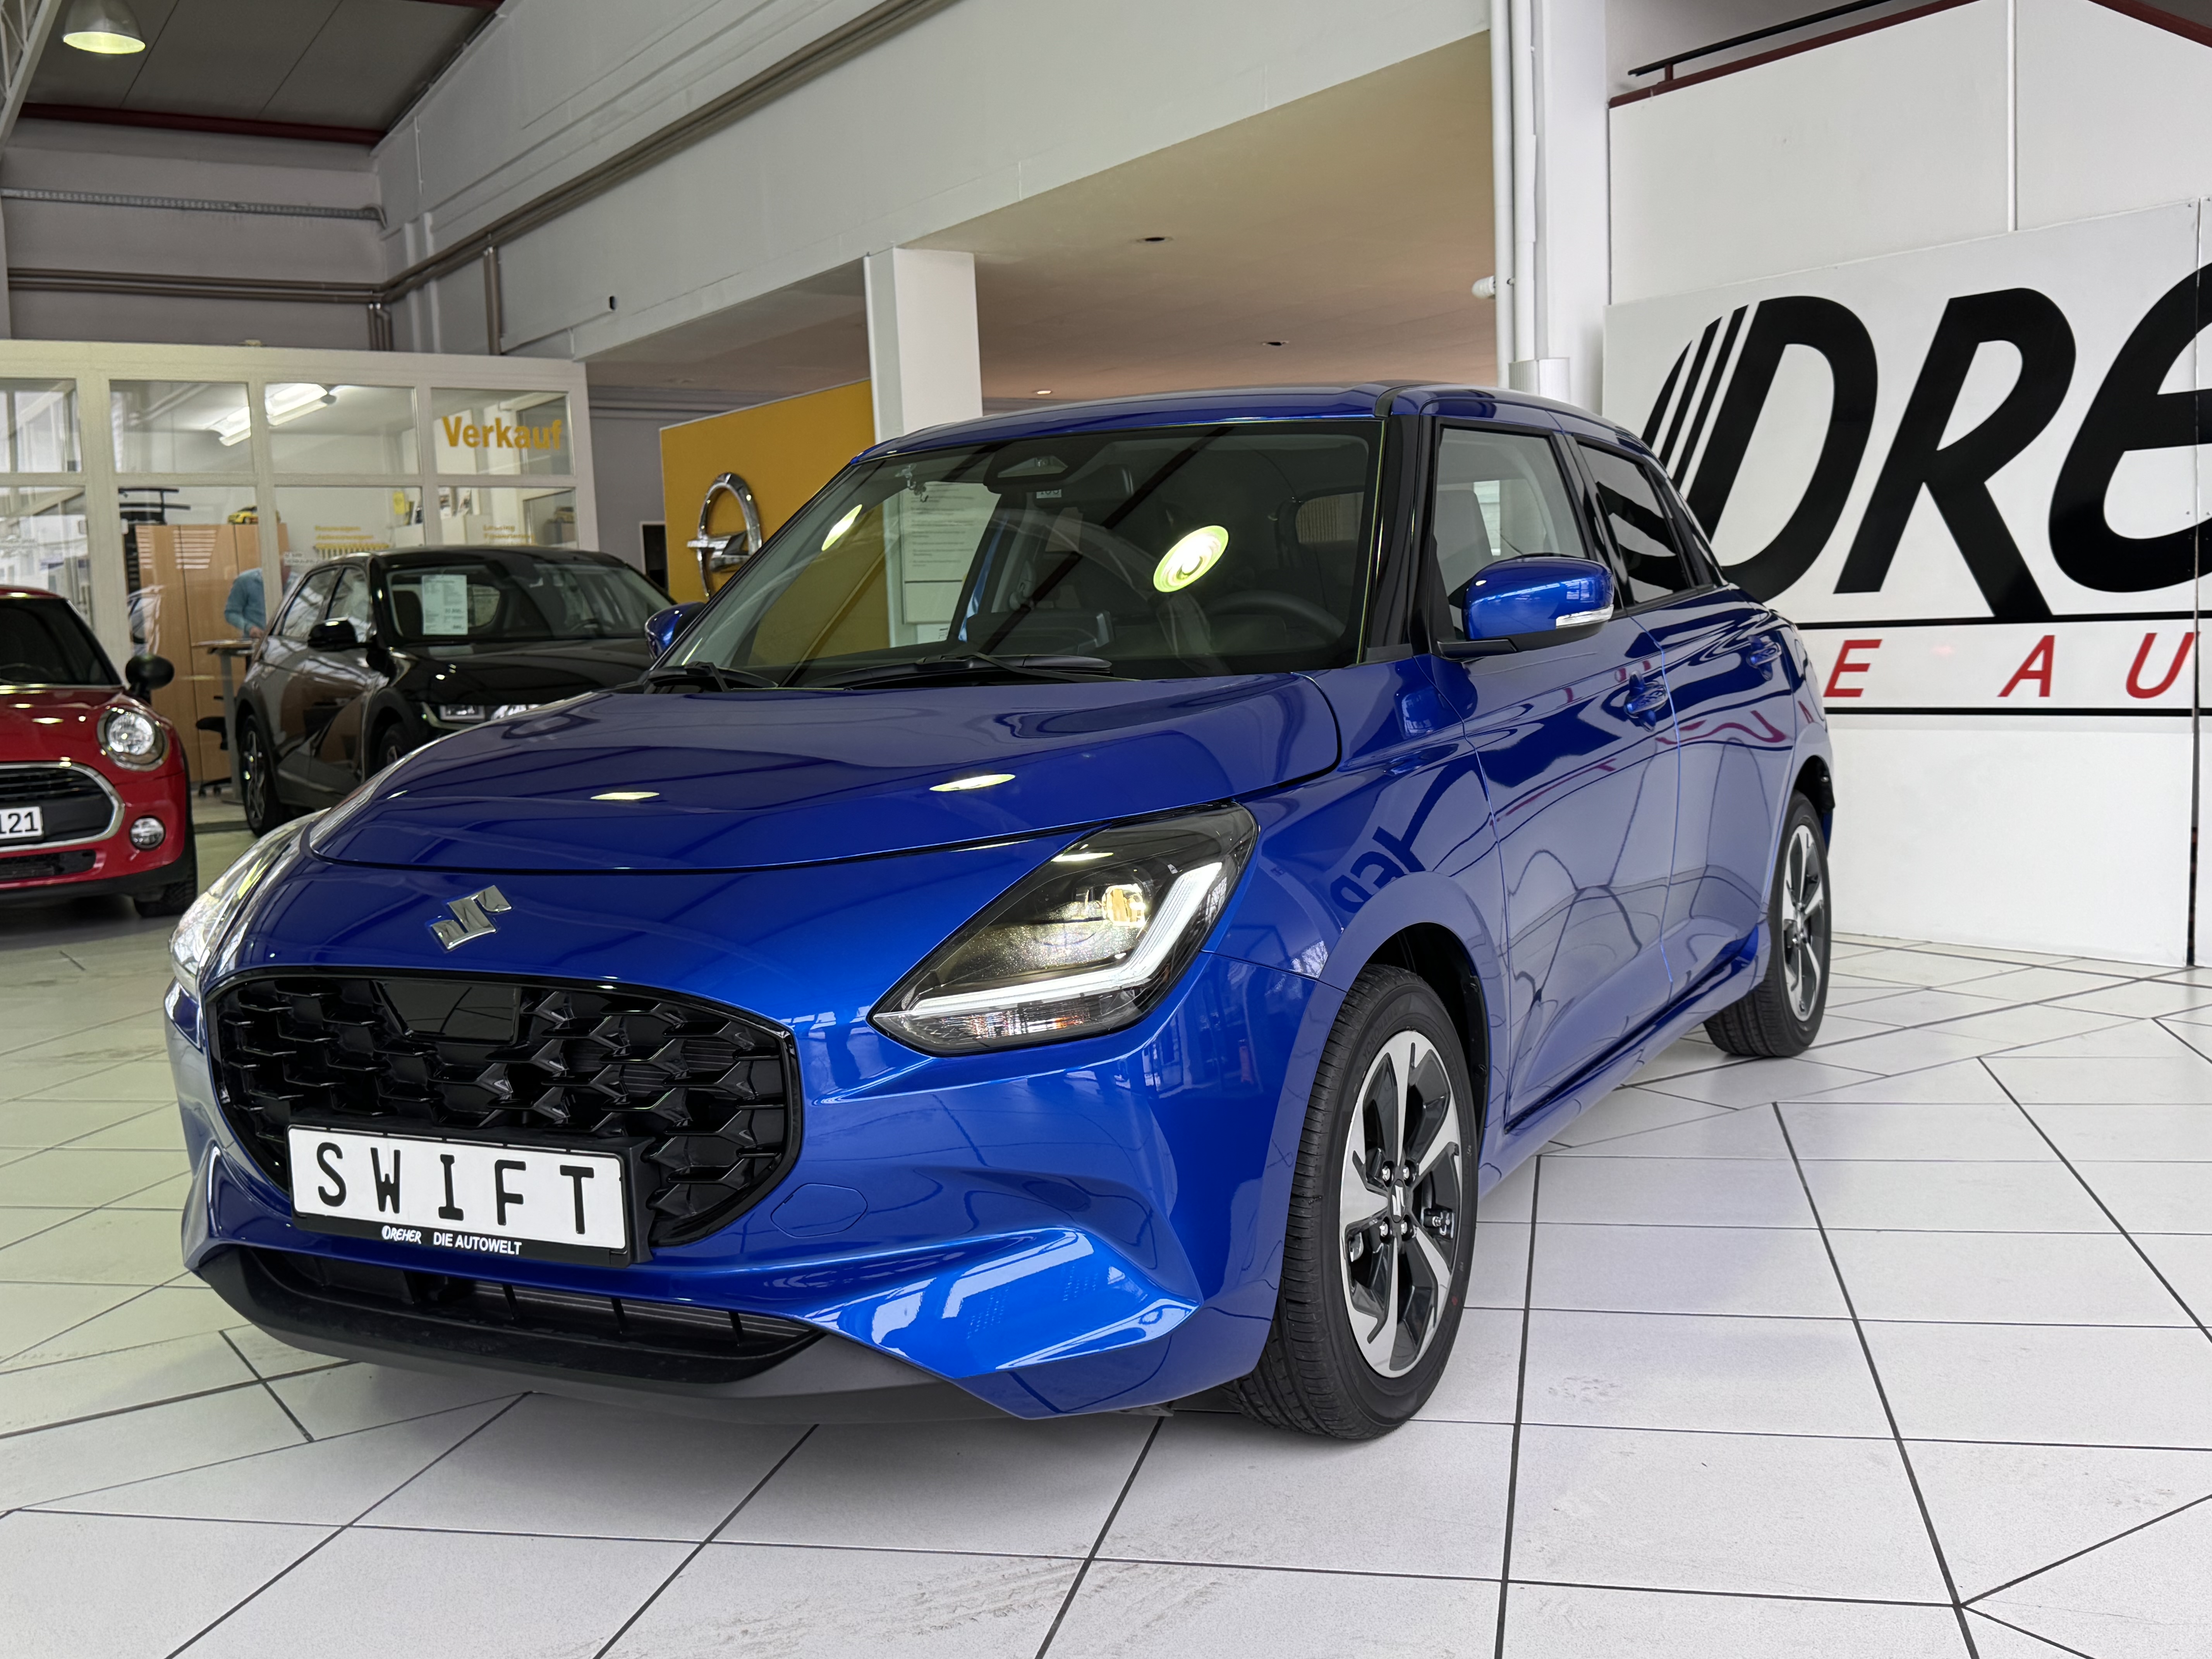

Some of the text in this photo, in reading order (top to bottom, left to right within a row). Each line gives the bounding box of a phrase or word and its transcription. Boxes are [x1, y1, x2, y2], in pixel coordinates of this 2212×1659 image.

[442, 416, 563, 450] Verkauf
[316, 1142, 594, 1235] SWIFT
[381, 1225, 522, 1255] DREHER DIE AUTOWELT
